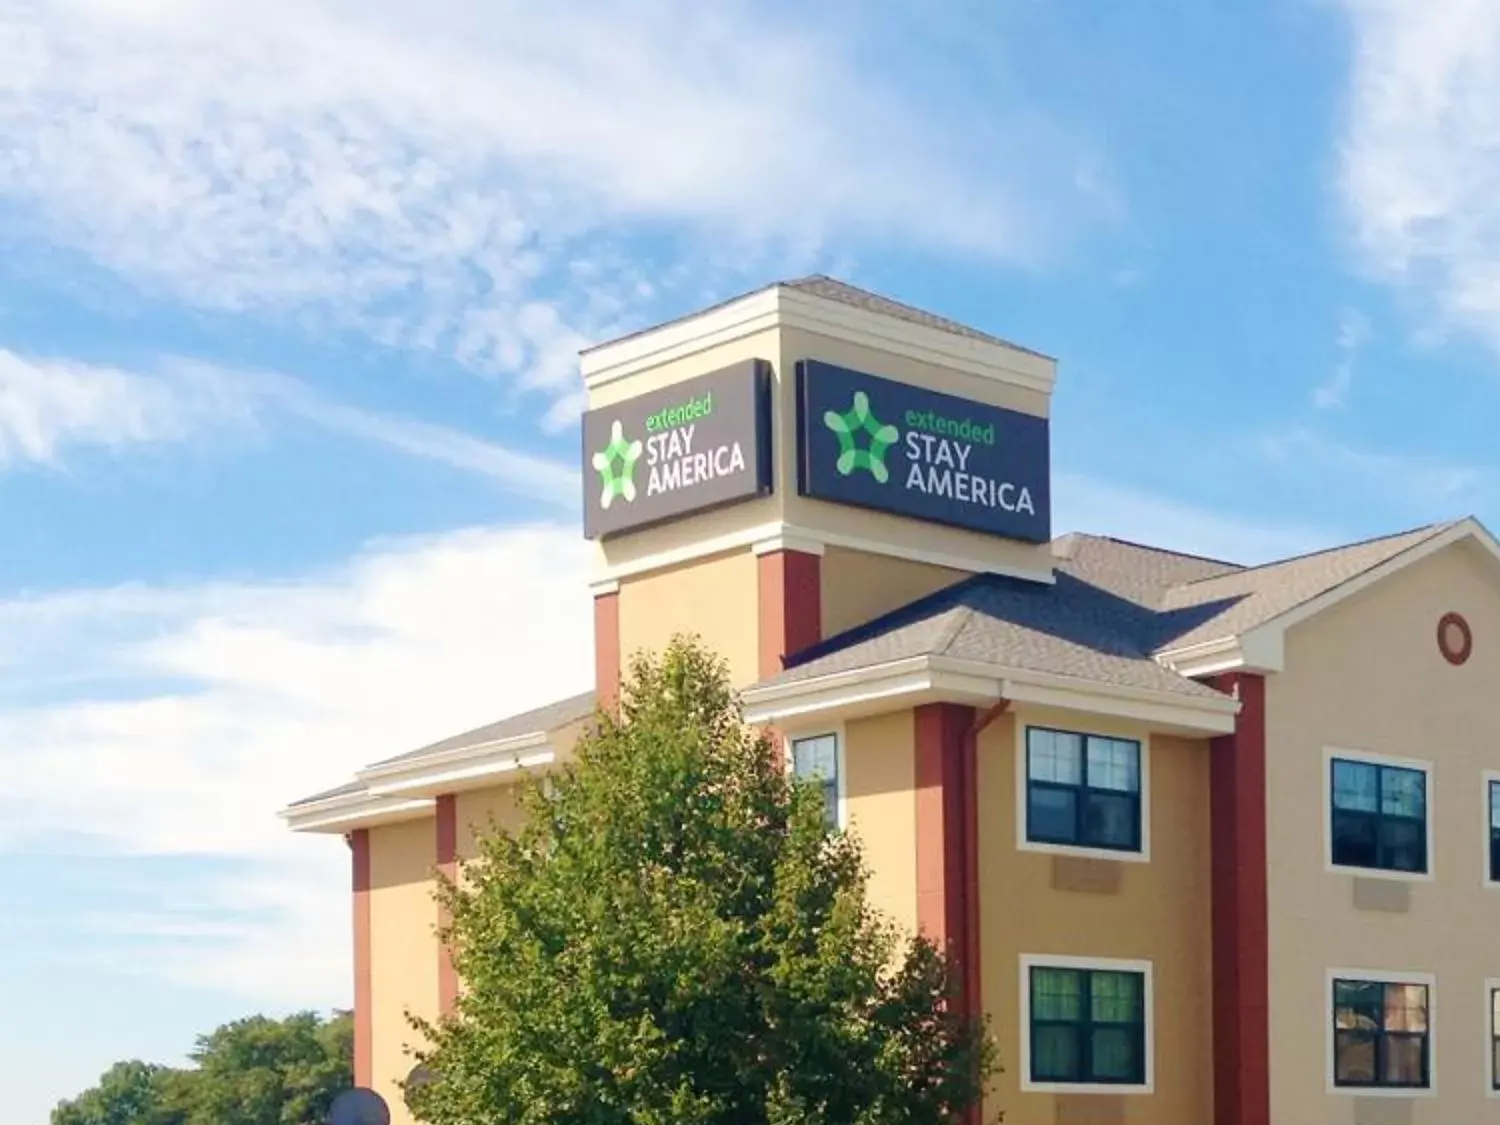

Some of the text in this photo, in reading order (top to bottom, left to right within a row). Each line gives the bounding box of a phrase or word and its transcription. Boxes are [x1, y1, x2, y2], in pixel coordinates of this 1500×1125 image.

[645, 392, 711, 432] extended
[905, 407, 995, 446] extended
[647, 424, 694, 465] STAY
[905, 431, 971, 471] STAY
[647, 442, 745, 497] AMERICA
[905, 463, 1035, 516] AMERICA
